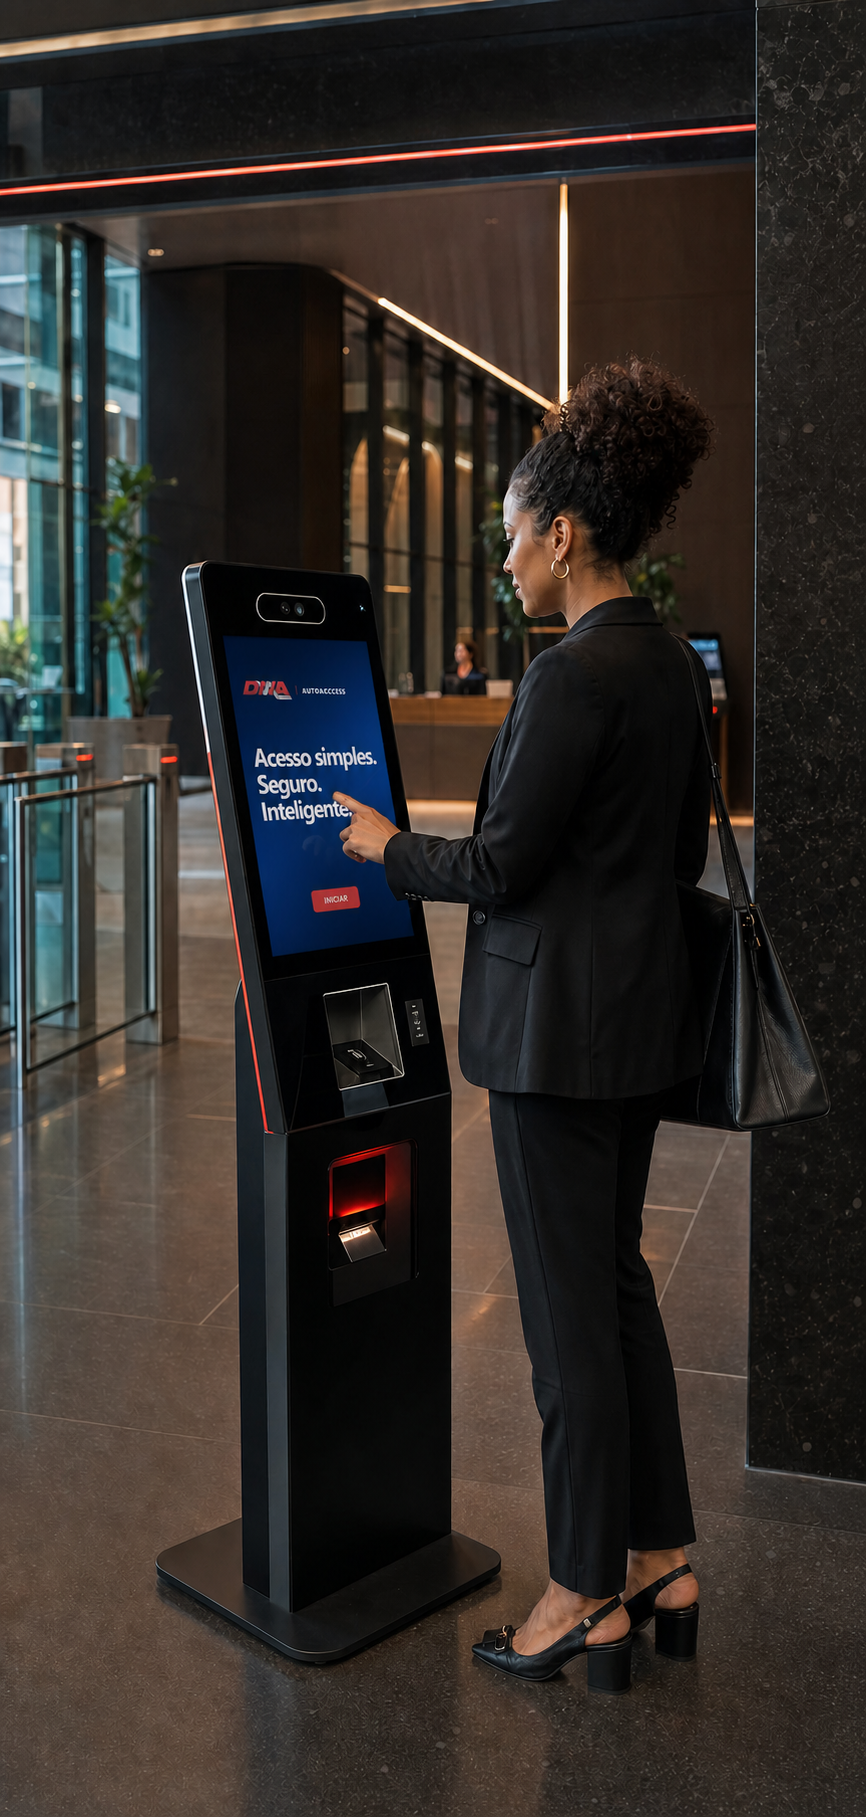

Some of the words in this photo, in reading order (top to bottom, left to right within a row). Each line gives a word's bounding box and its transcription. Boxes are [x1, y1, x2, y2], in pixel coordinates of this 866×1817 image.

[254, 748, 312, 767] Acesso
[315, 746, 377, 771] simples.
[257, 775, 322, 799] Seguro.
